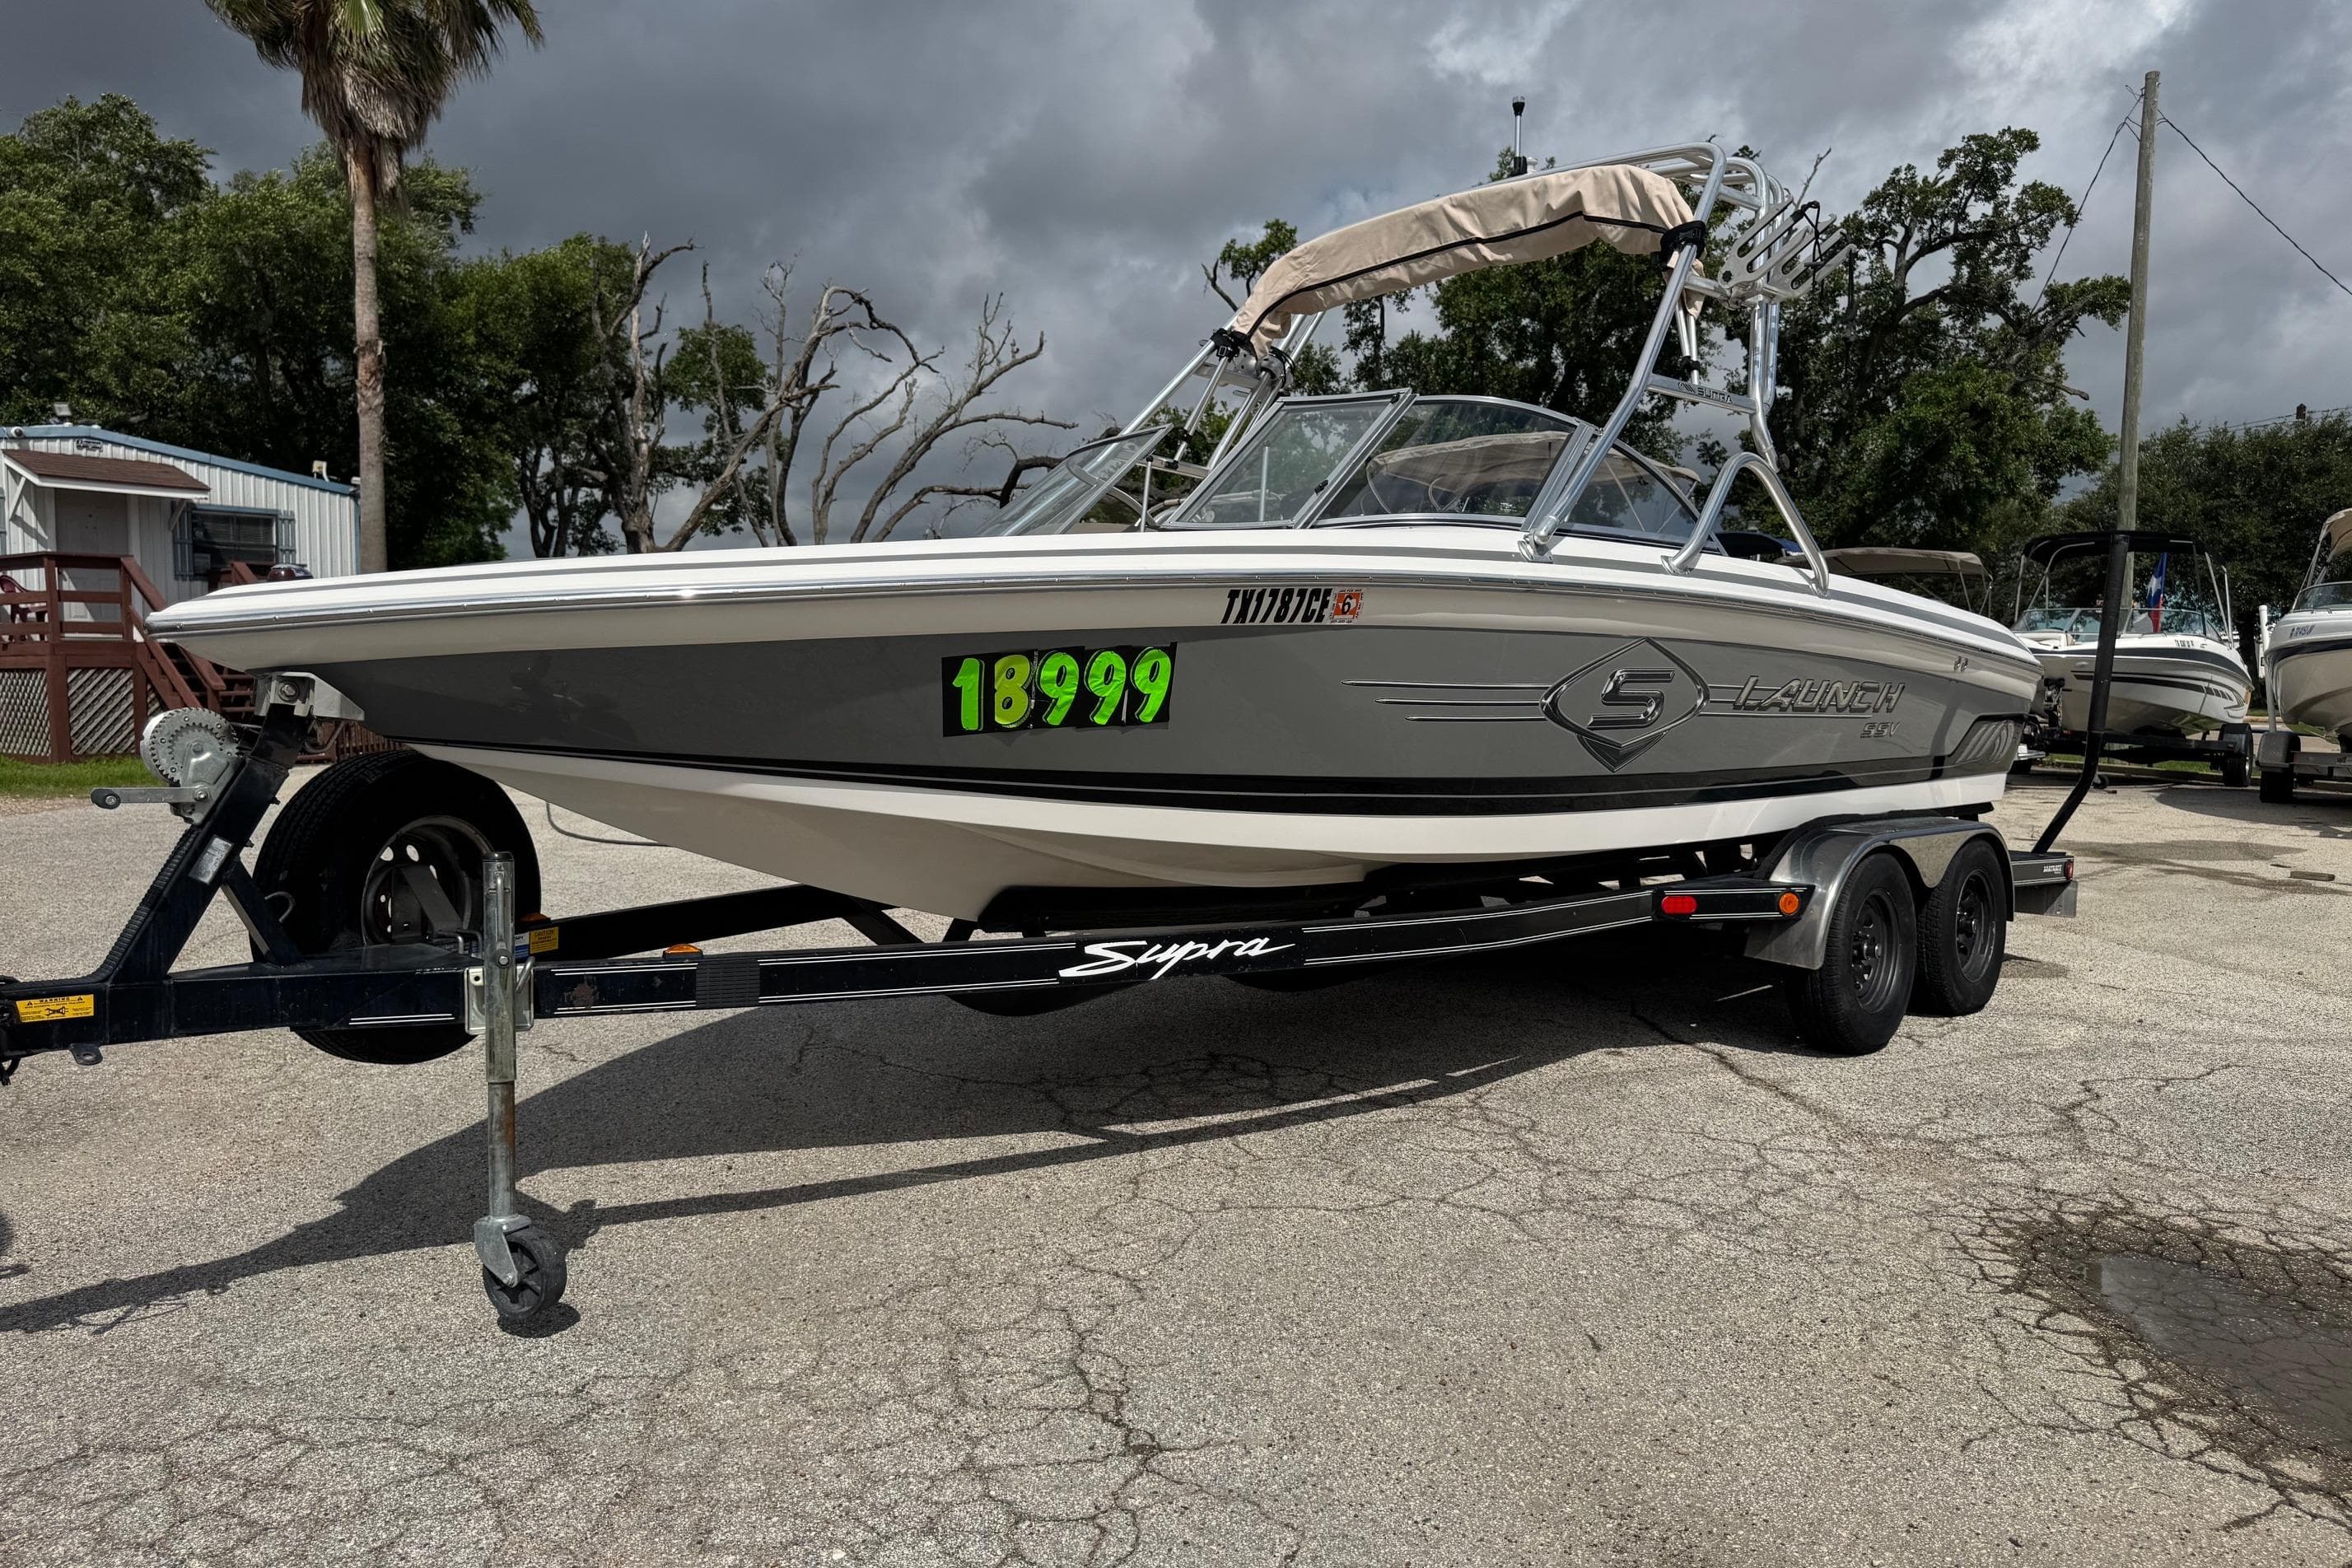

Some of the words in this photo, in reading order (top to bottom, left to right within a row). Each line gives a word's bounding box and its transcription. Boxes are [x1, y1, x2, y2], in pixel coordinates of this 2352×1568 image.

[1220, 588, 1332, 623] TX1787CE
[1342, 594, 1353, 615] 6
[952, 647, 1172, 731] 18999
[1733, 675, 1906, 712] LAUNCH
[1058, 937, 1296, 980] Supra
